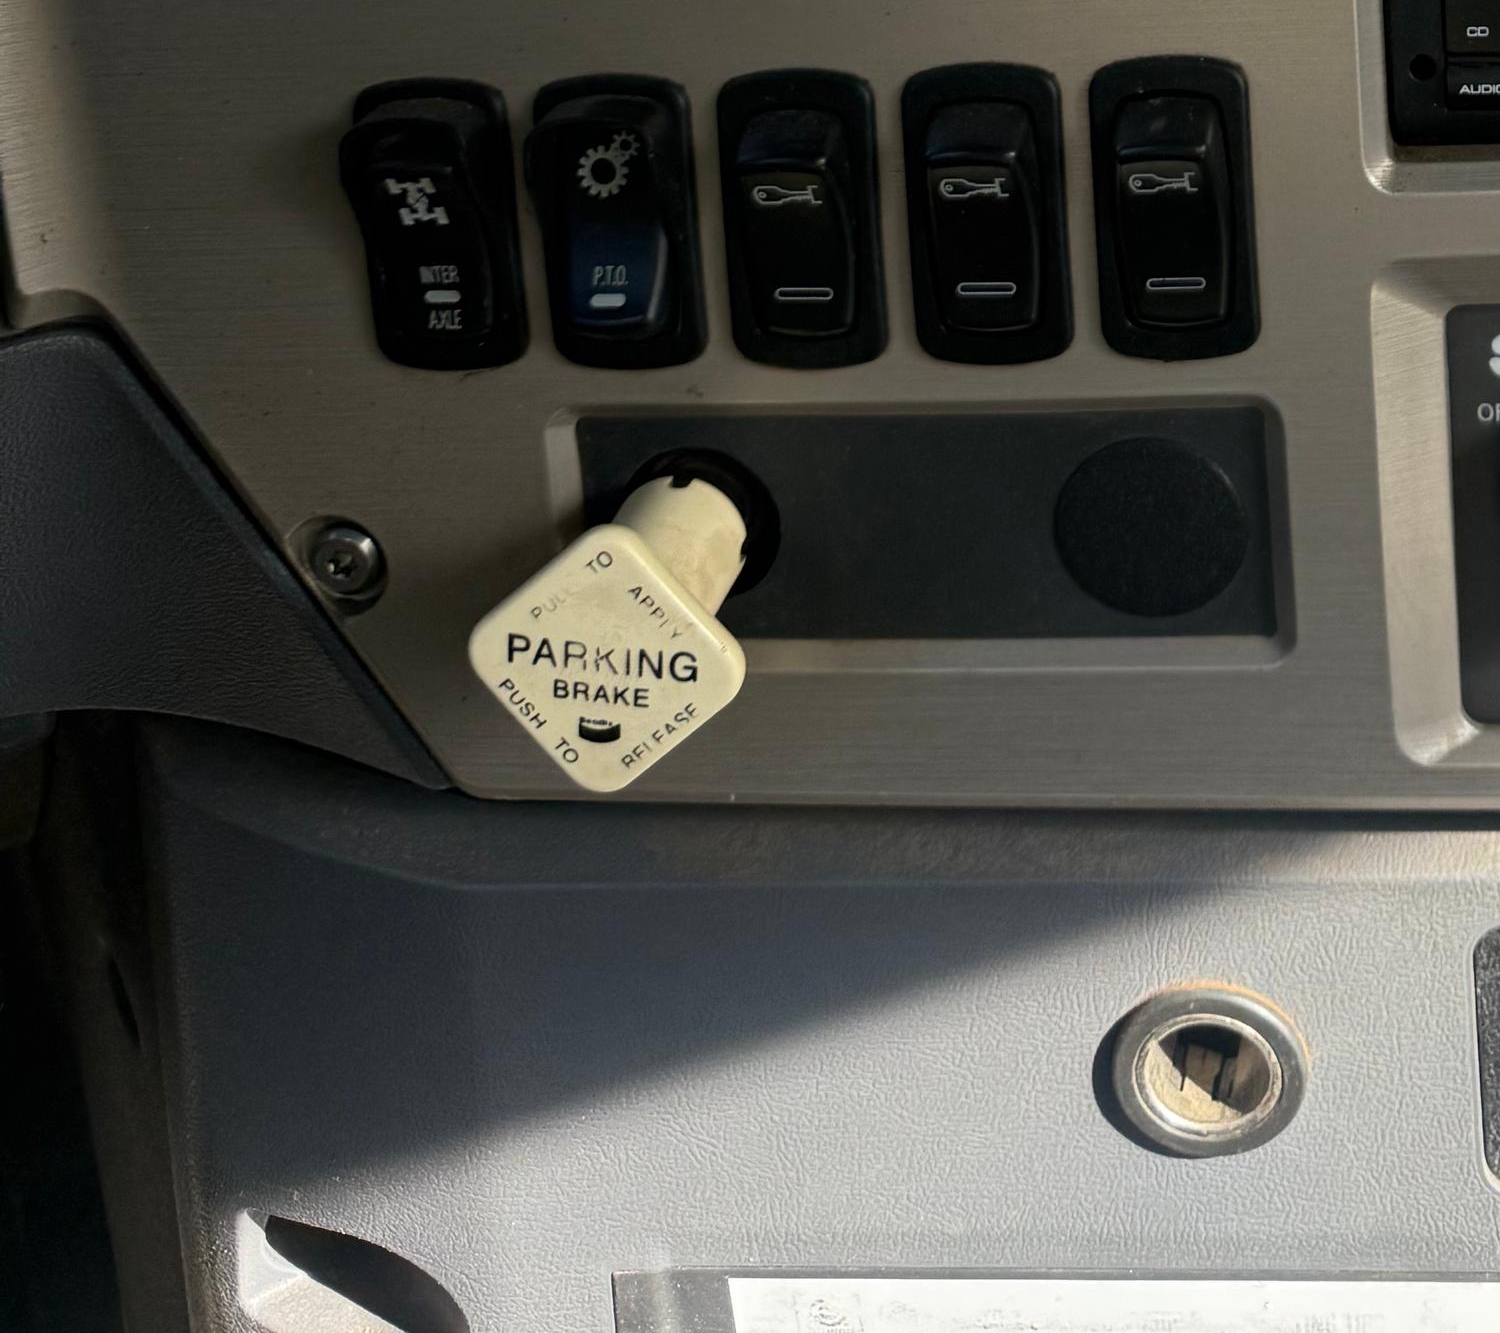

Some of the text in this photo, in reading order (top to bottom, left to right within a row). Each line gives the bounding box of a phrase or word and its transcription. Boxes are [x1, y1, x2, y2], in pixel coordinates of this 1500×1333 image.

[1467, 26, 1489, 37] CD
[428, 309, 462, 329] AXLE
[585, 551, 614, 575] TO
[508, 633, 698, 683] PARKING
[553, 679, 650, 708] BRAKE
[498, 678, 548, 729] PUSH
[554, 737, 579, 764] TO
